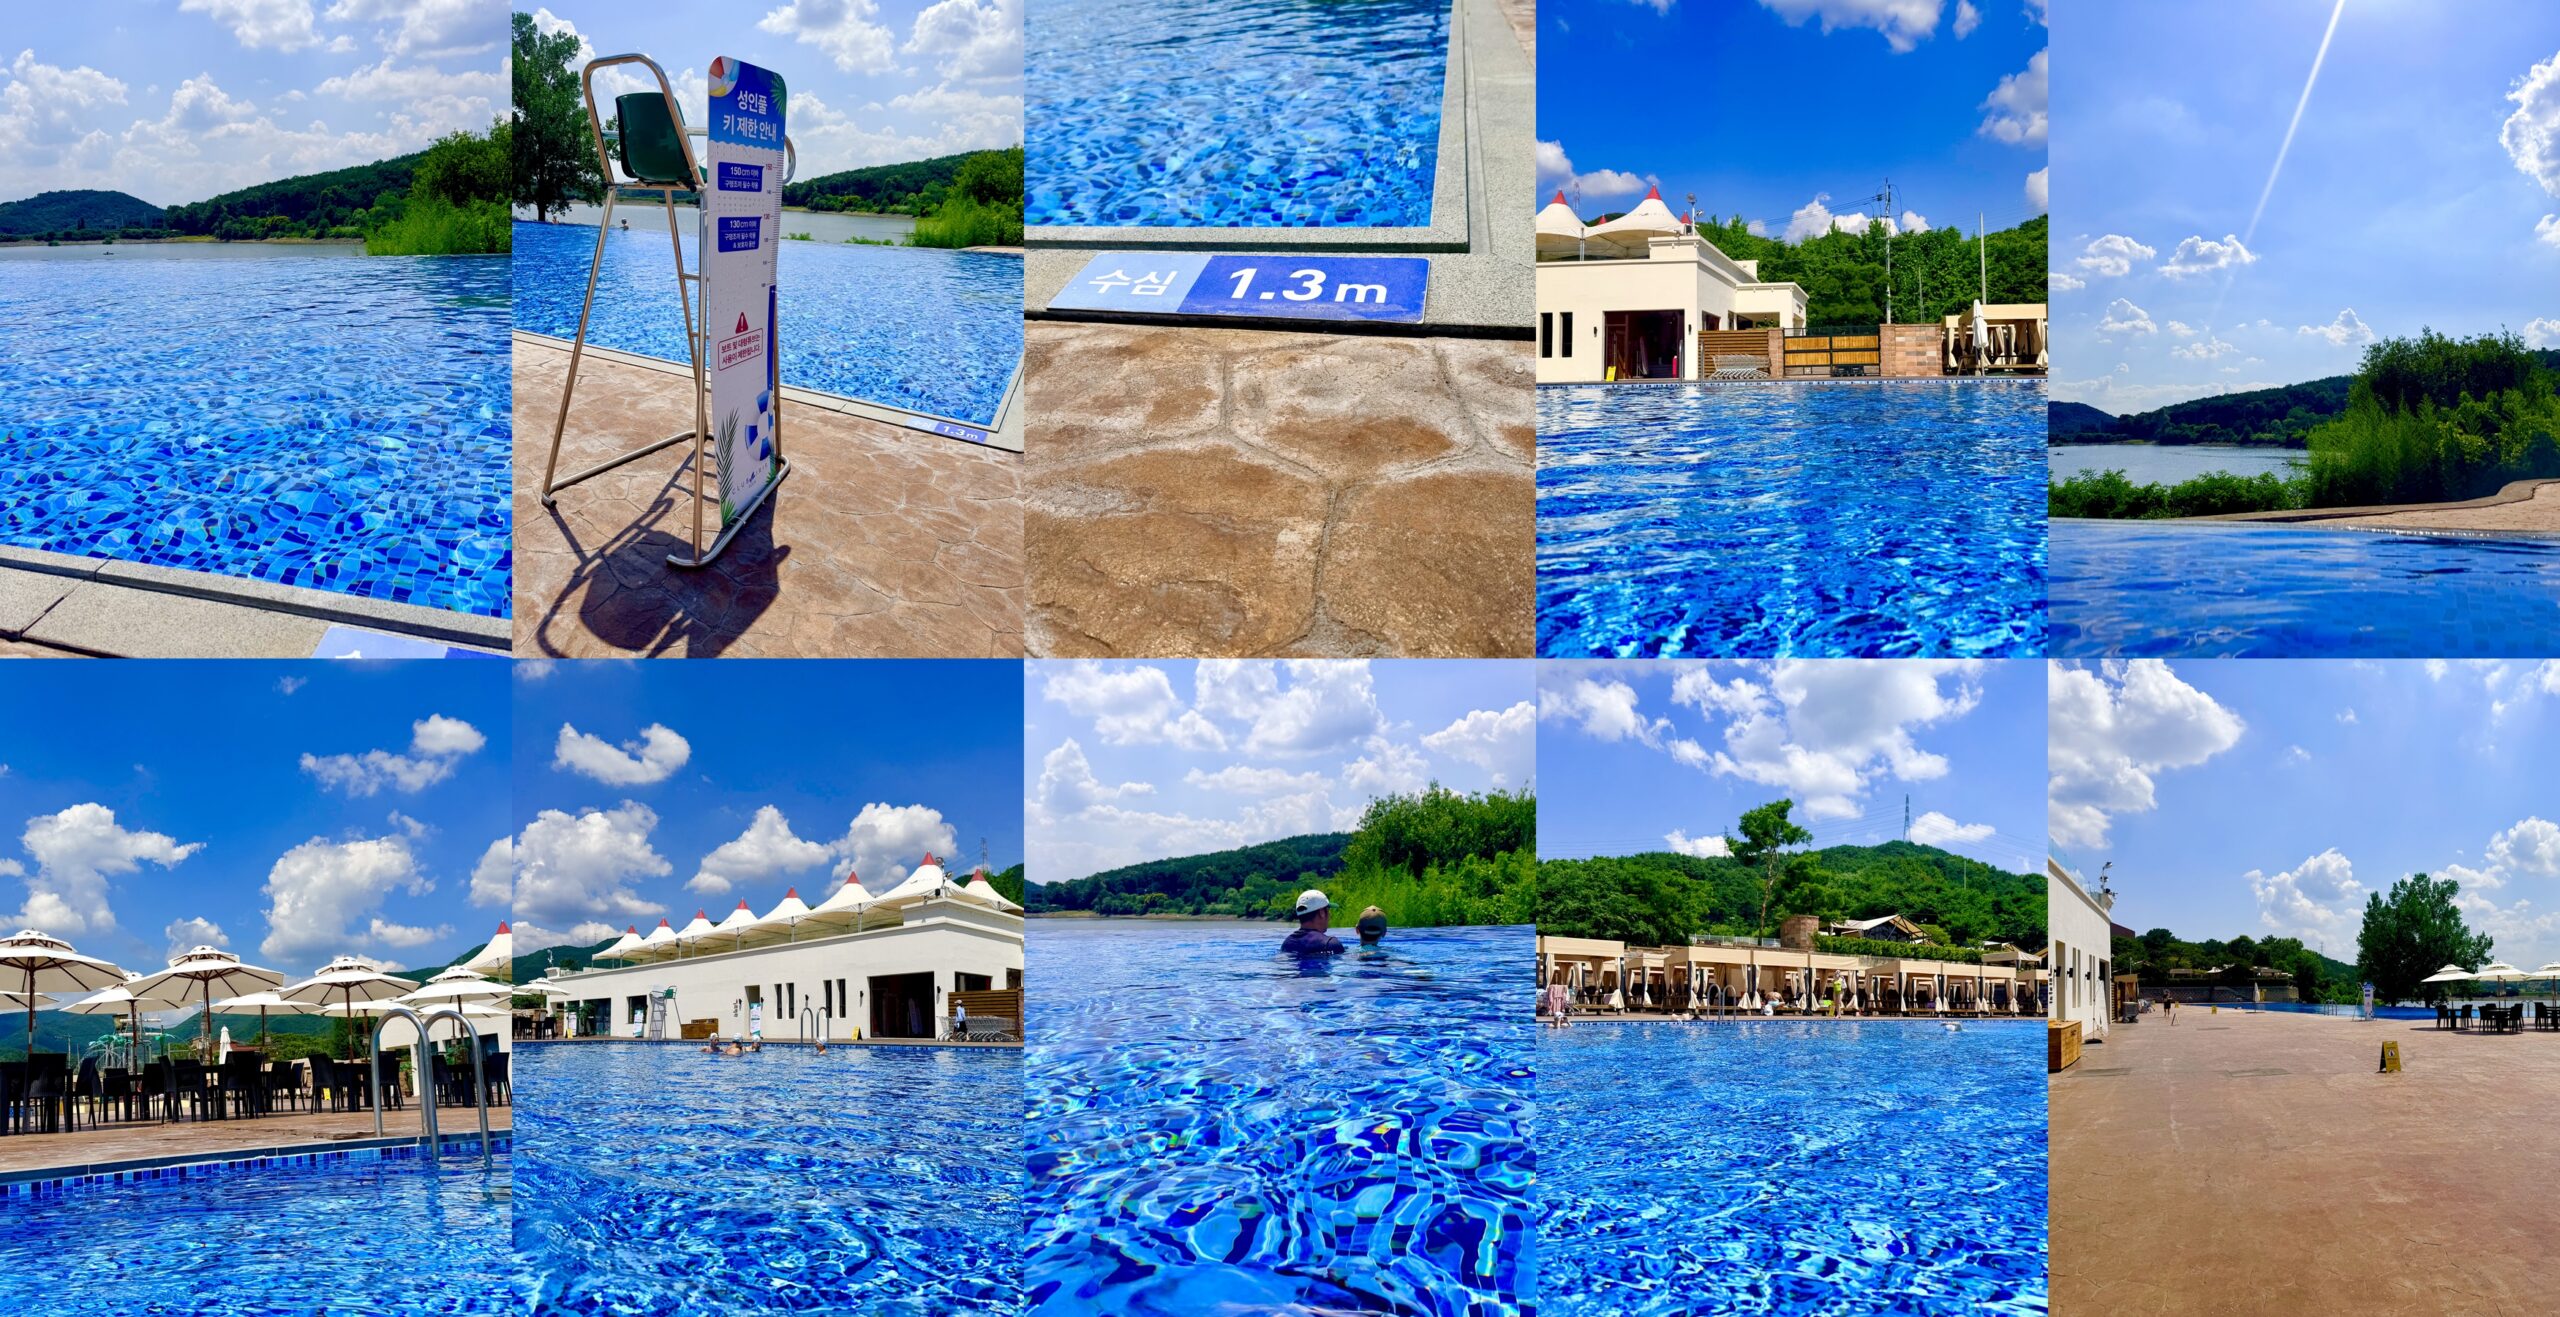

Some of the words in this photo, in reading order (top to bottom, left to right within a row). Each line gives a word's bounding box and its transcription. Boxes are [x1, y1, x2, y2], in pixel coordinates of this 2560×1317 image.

[737, 90, 768, 115] 성인풀
[723, 114, 734, 136] 키
[737, 116, 758, 139] 제한
[759, 121, 777, 142] 안내
[1088, 269, 1178, 296] 수심
